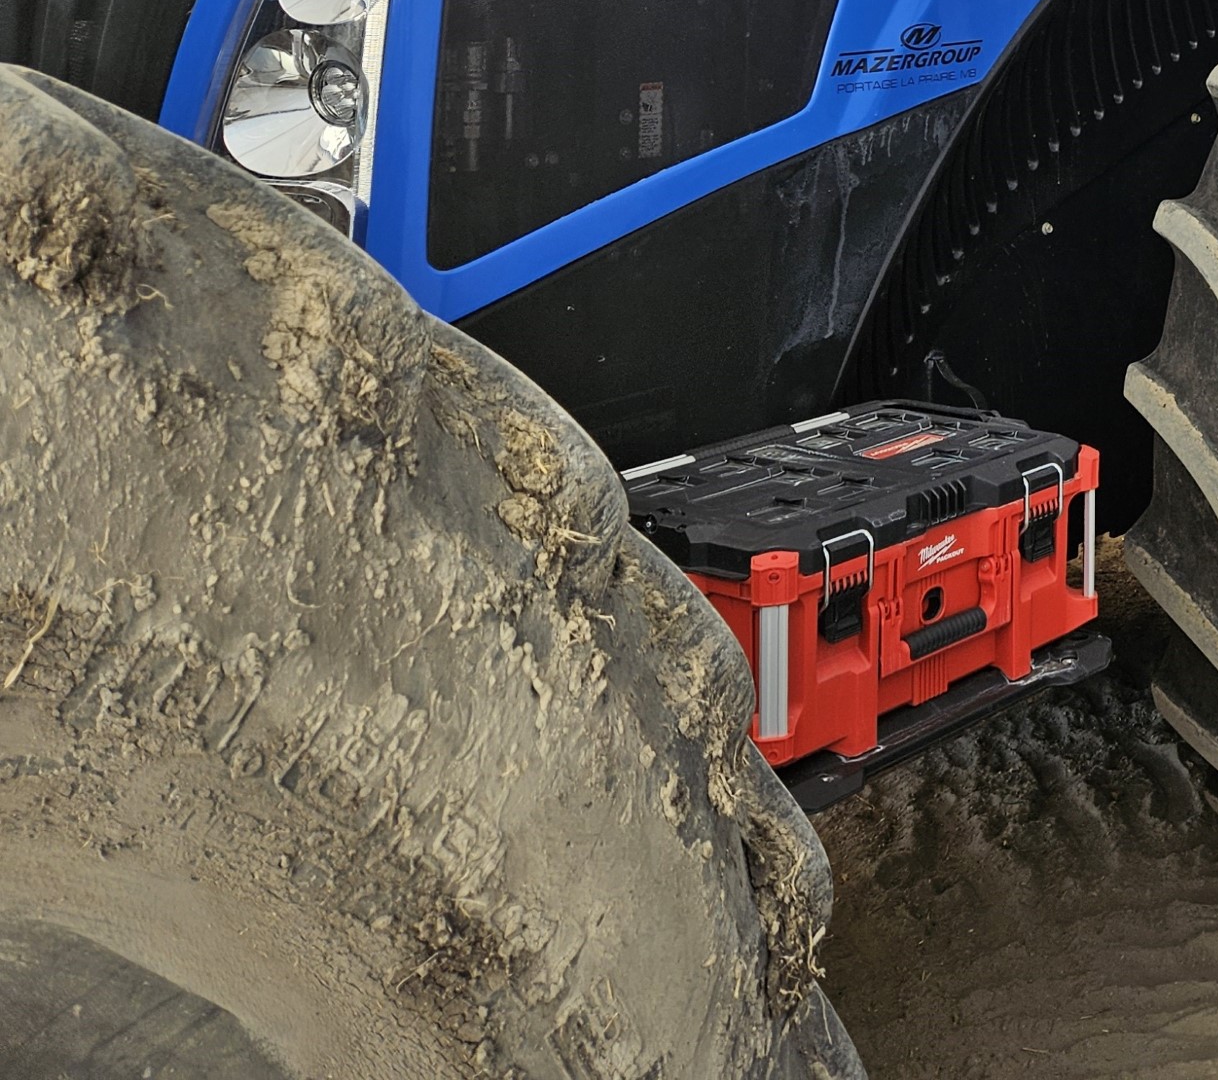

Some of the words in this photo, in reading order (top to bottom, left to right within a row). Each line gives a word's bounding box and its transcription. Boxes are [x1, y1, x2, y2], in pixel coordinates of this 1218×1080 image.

[831, 46, 981, 77] MAZERGROUP
[837, 78, 898, 94] PORTAGE
[901, 77, 915, 88] LA
